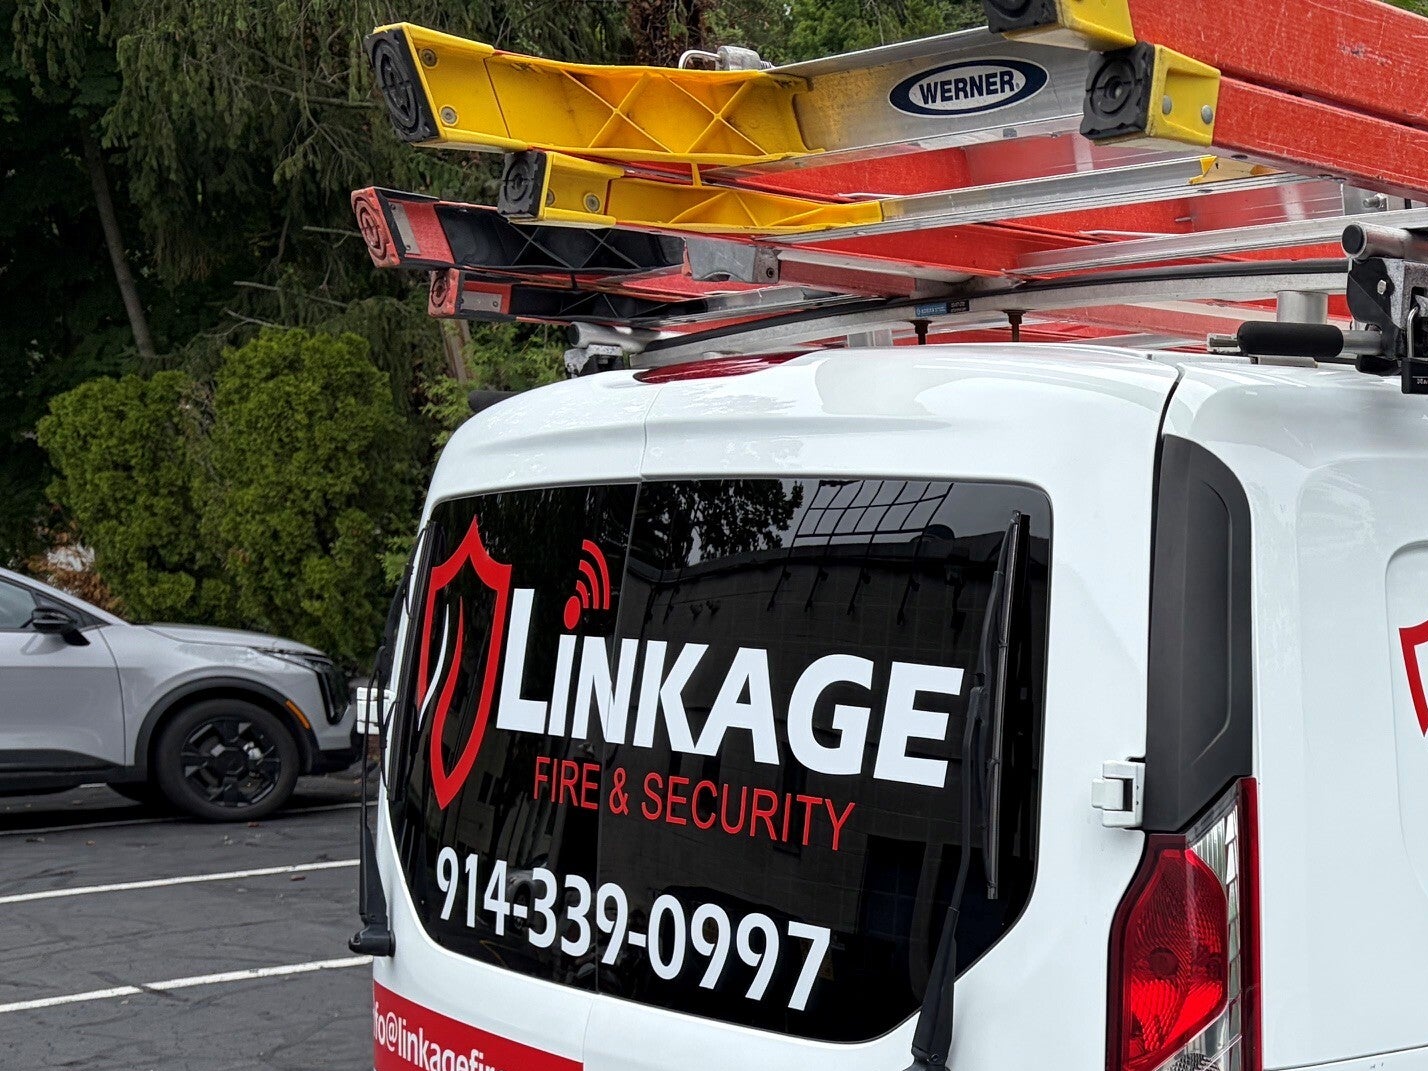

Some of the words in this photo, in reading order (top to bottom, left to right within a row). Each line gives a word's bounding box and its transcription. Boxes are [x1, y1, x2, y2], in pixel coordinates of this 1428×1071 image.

[919, 70, 1015, 105] WERNER
[532, 756, 600, 811] FIRE
[608, 767, 629, 815] &
[641, 771, 855, 851] SECURITY
[435, 846, 832, 1011] 914-339-0997
